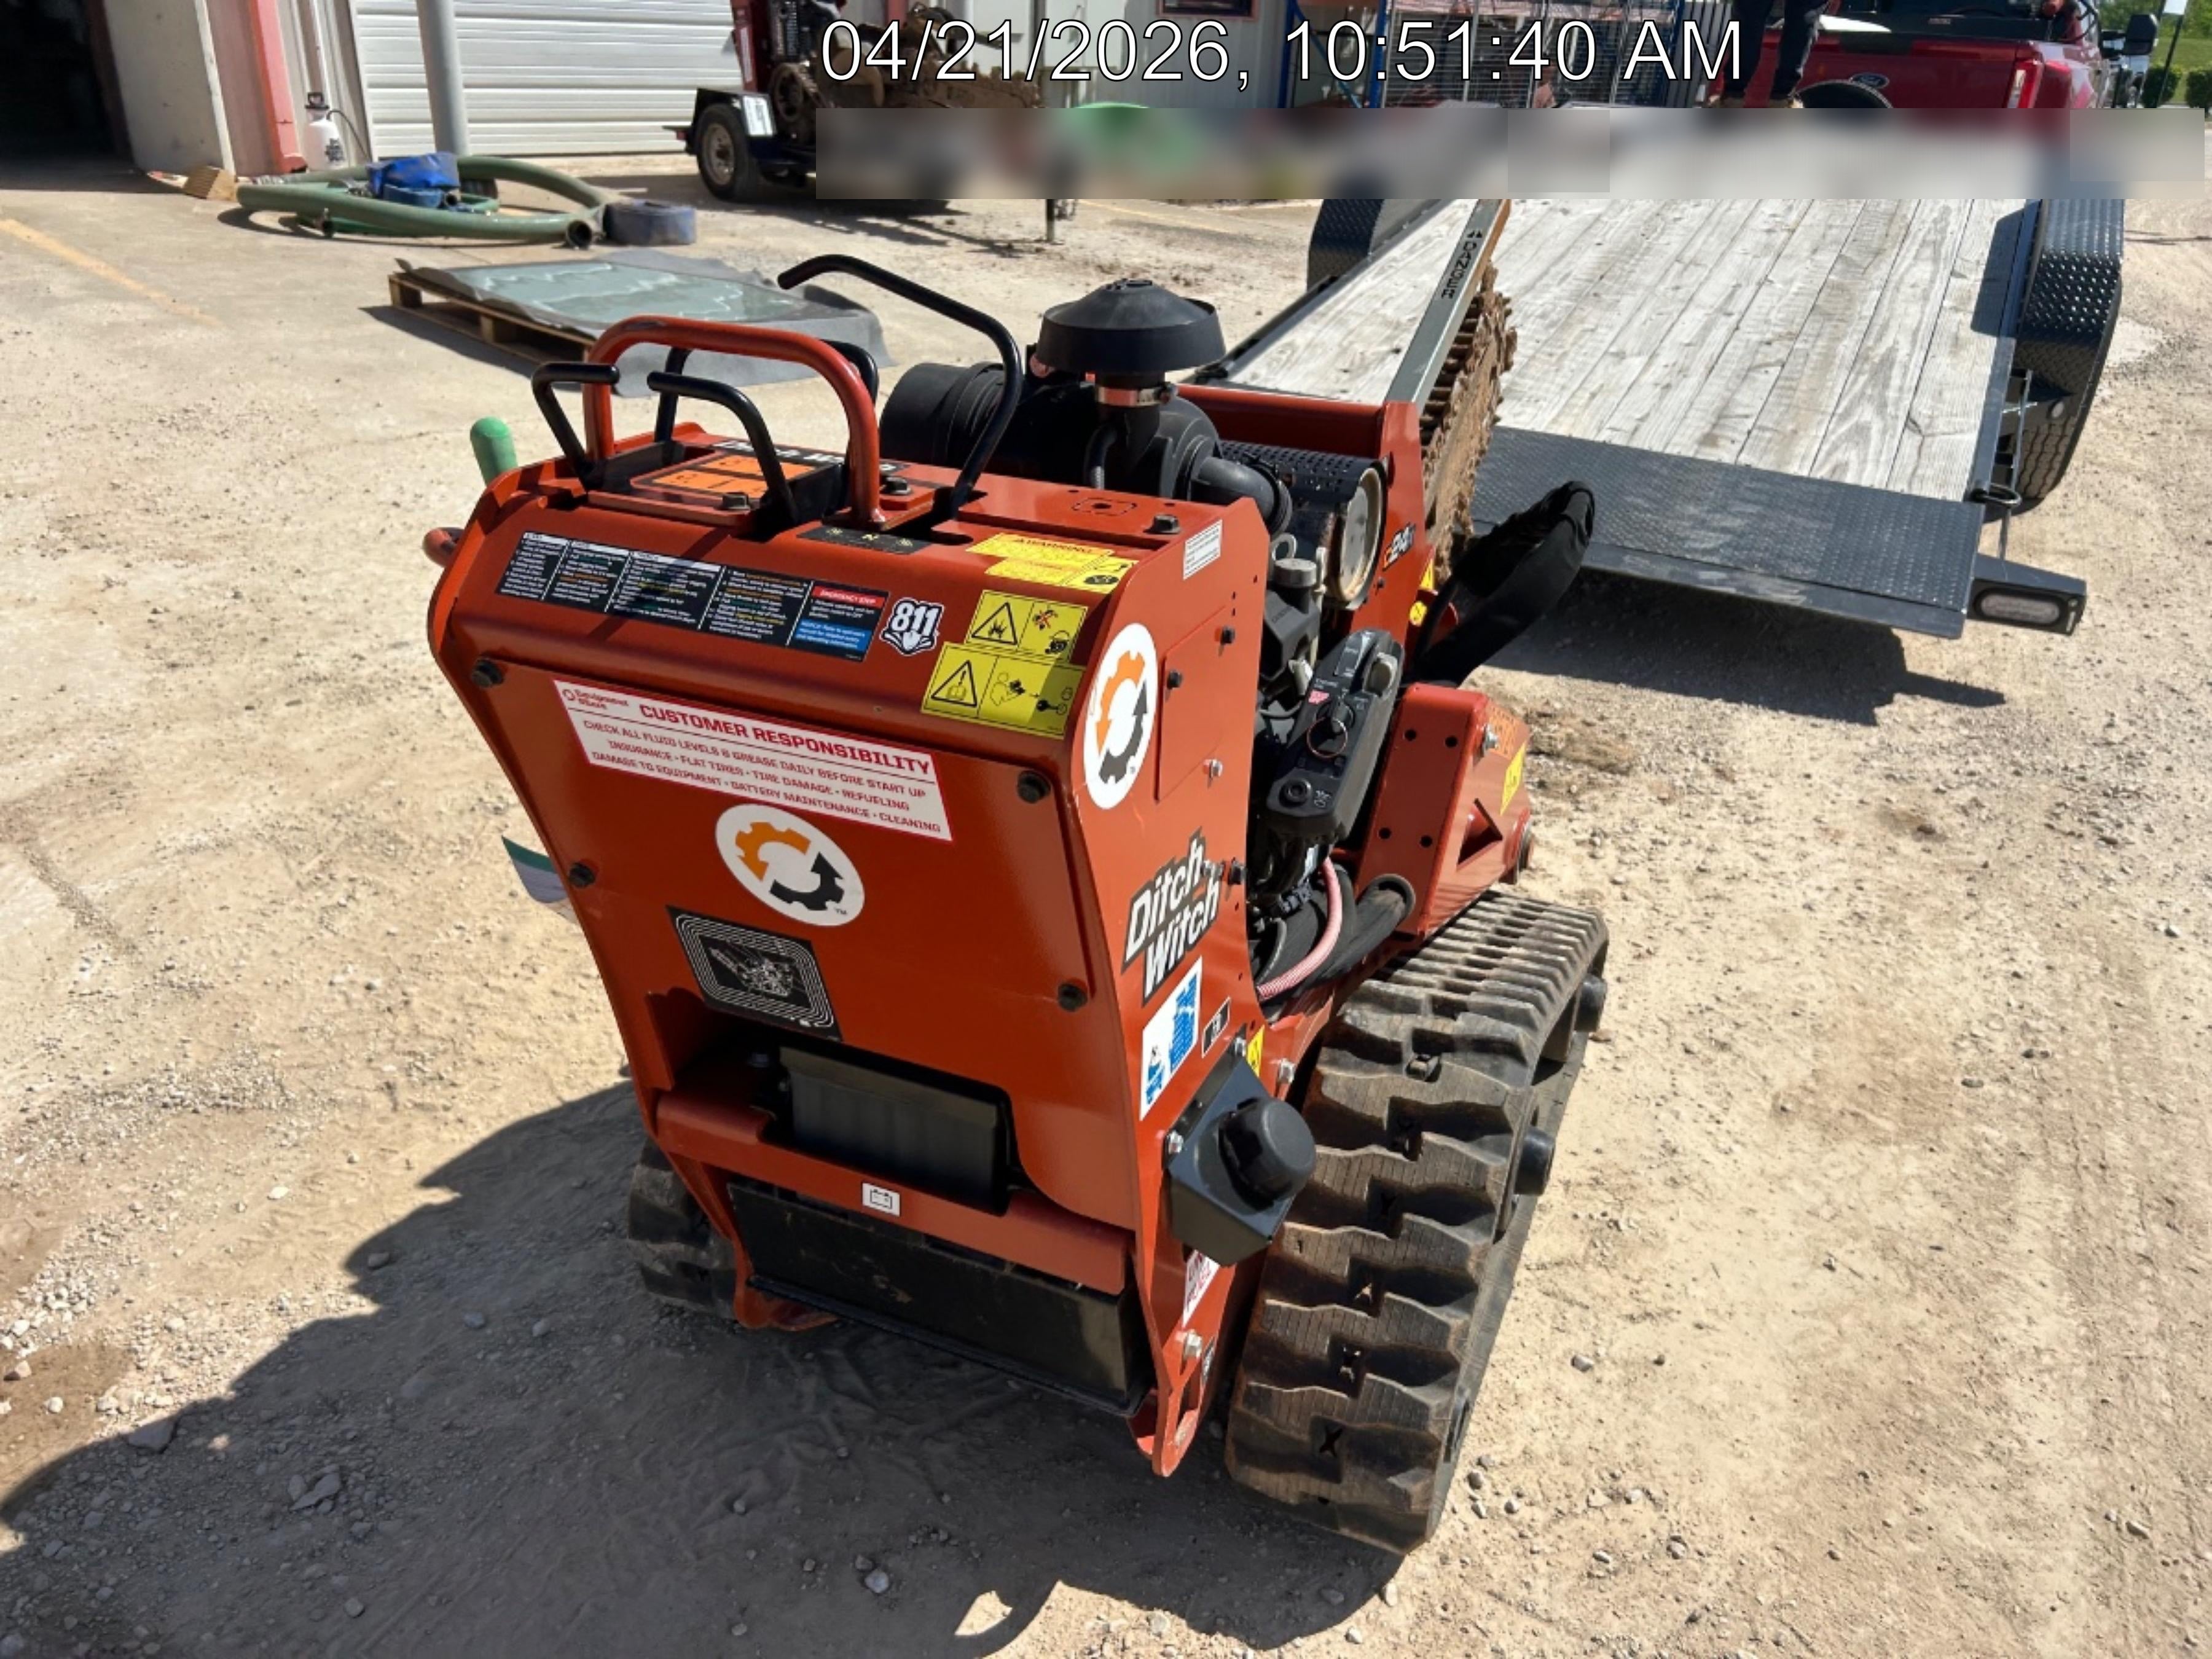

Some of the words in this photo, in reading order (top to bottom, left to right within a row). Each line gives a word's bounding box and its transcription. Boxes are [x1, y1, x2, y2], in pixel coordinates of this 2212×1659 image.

[1441, 241, 1477, 299] DANGER
[891, 602, 939, 637] 811
[583, 720, 621, 735] CHECK
[622, 728, 641, 740] ALL
[643, 732, 677, 748] FLUID
[678, 738, 720, 756] LEVELS
[732, 751, 778, 769] GREASE
[780, 761, 815, 776] DAILY
[818, 768, 864, 786] BEFORE
[866, 778, 905, 794] START
[908, 786, 926, 798] UP
[608, 739, 673, 762] INSURANCE
[680, 755, 708, 769] FLAT
[710, 761, 744, 777] TIRES
[782, 776, 834, 796] DAMAGE
[841, 788, 909, 811] REFUELING
[639, 704, 749, 738] CUSTOMER
[753, 726, 930, 775] RESPONSIBILITY
[591, 751, 638, 768] DAMAGE
[639, 761, 654, 772] TO
[656, 765, 723, 786] EQUIPMENT
[731, 781, 781, 799] BATTERY
[783, 791, 871, 819] MAINTENANCE
[879, 812, 941, 833] CLEANING
[1124, 837, 1205, 963] Ditch
[1143, 877, 1221, 998] Witch
